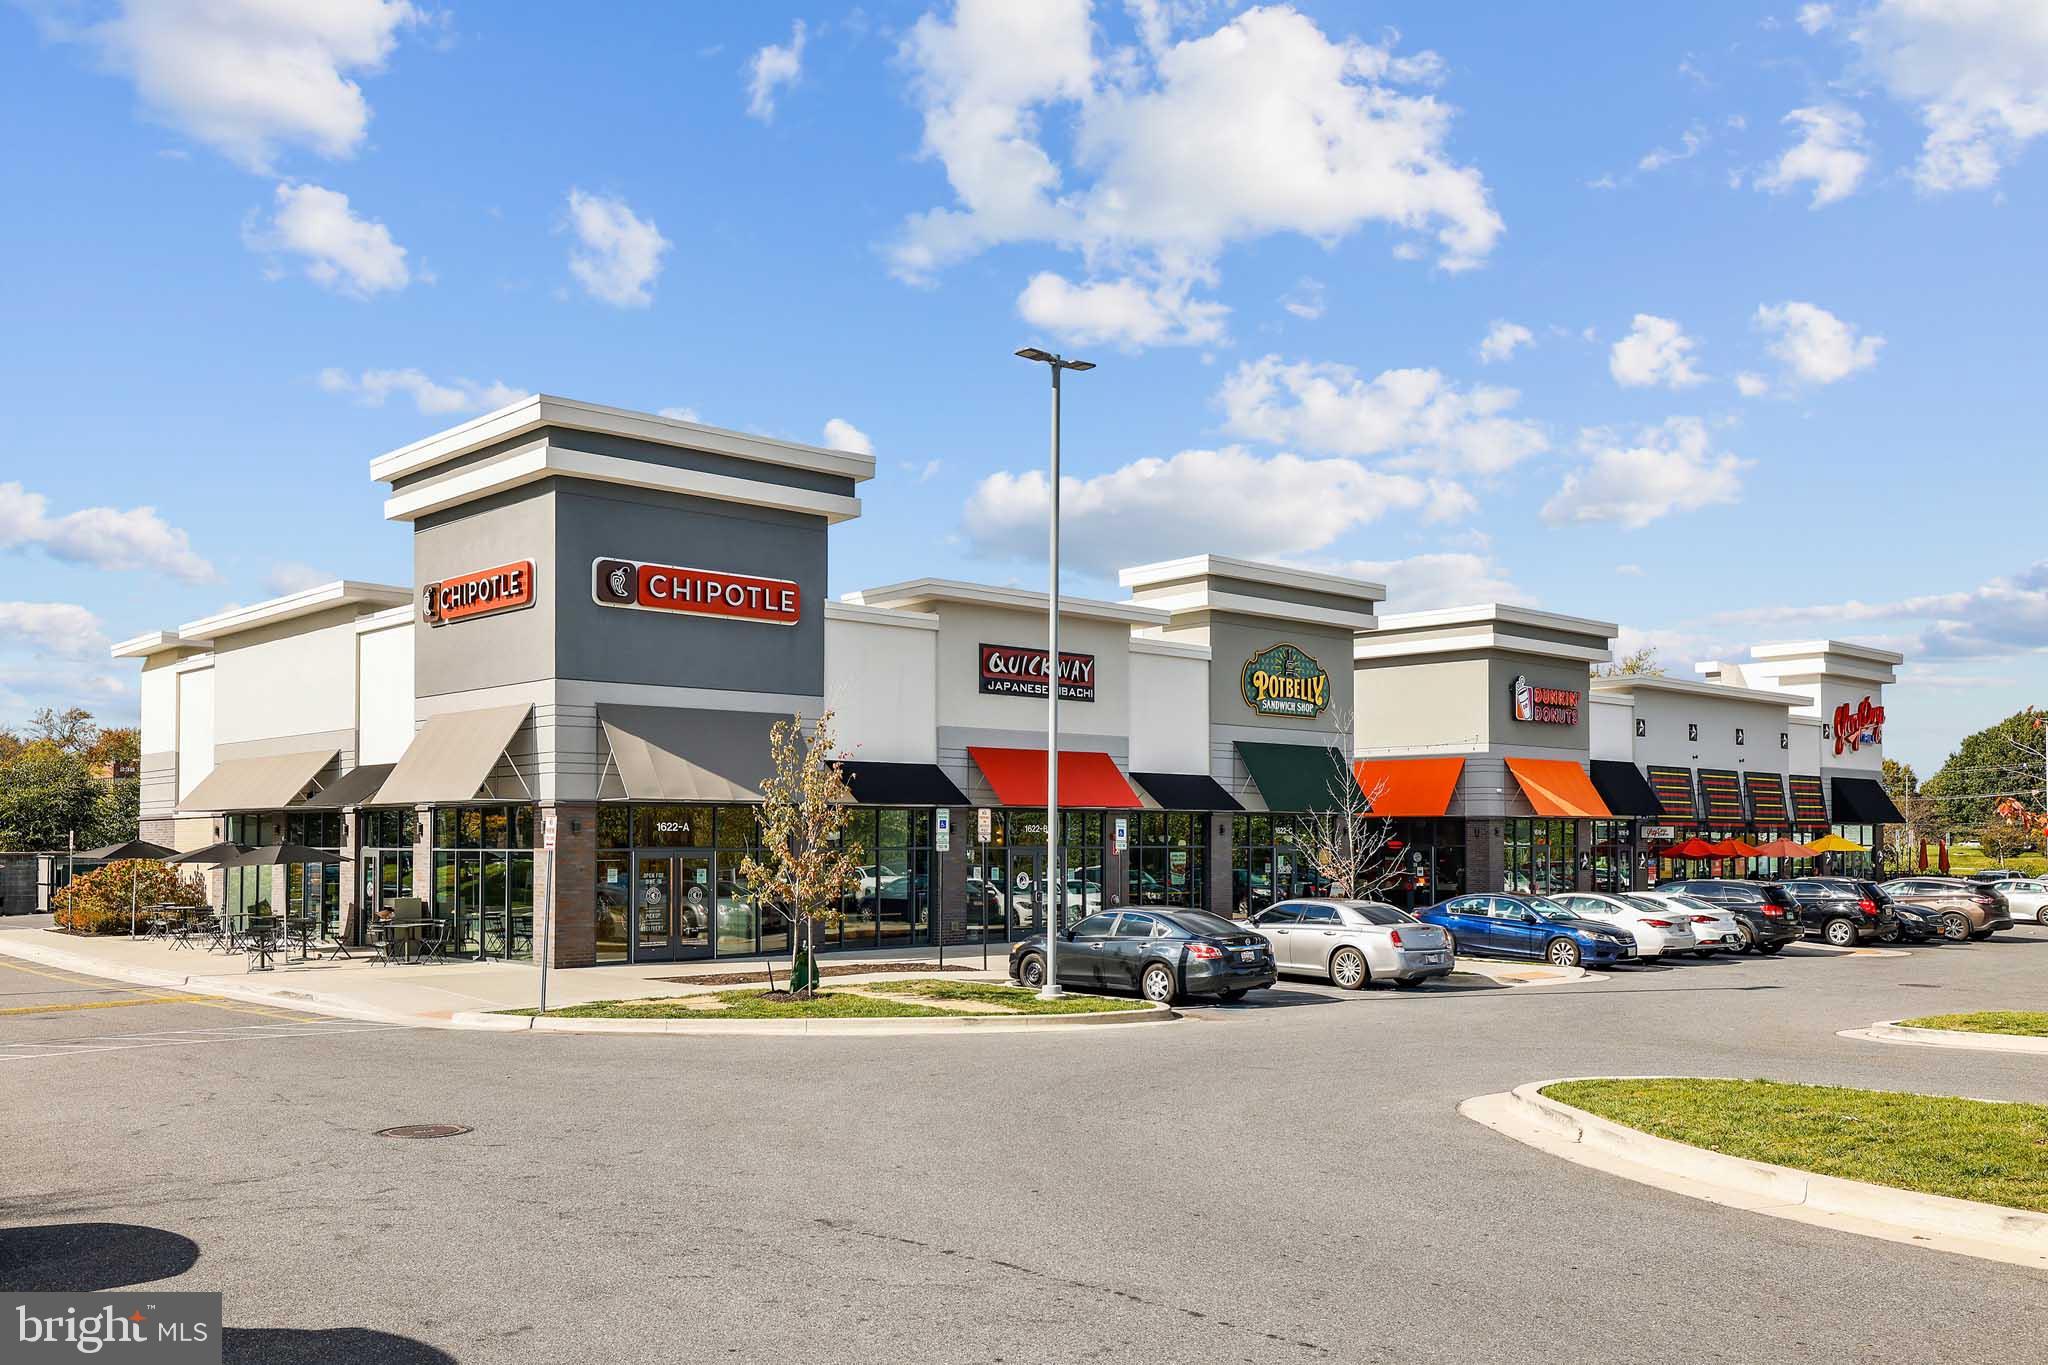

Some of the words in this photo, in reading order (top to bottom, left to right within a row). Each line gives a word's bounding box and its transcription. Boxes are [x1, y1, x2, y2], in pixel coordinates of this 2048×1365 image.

[440, 570, 520, 608] CHIPOTLE
[649, 575, 795, 612] CHIPOTLE
[988, 652, 1094, 682] QUICKWAY
[988, 681, 1049, 694] JAPANESE
[1057, 687, 1094, 698] IBACHI
[1253, 670, 1326, 706] POTBELLY
[1262, 699, 1296, 711] SANDWICH
[1296, 702, 1314, 713] SHOP
[1534, 706, 1579, 725] DONUTS
[656, 821, 690, 832] 1622-A
